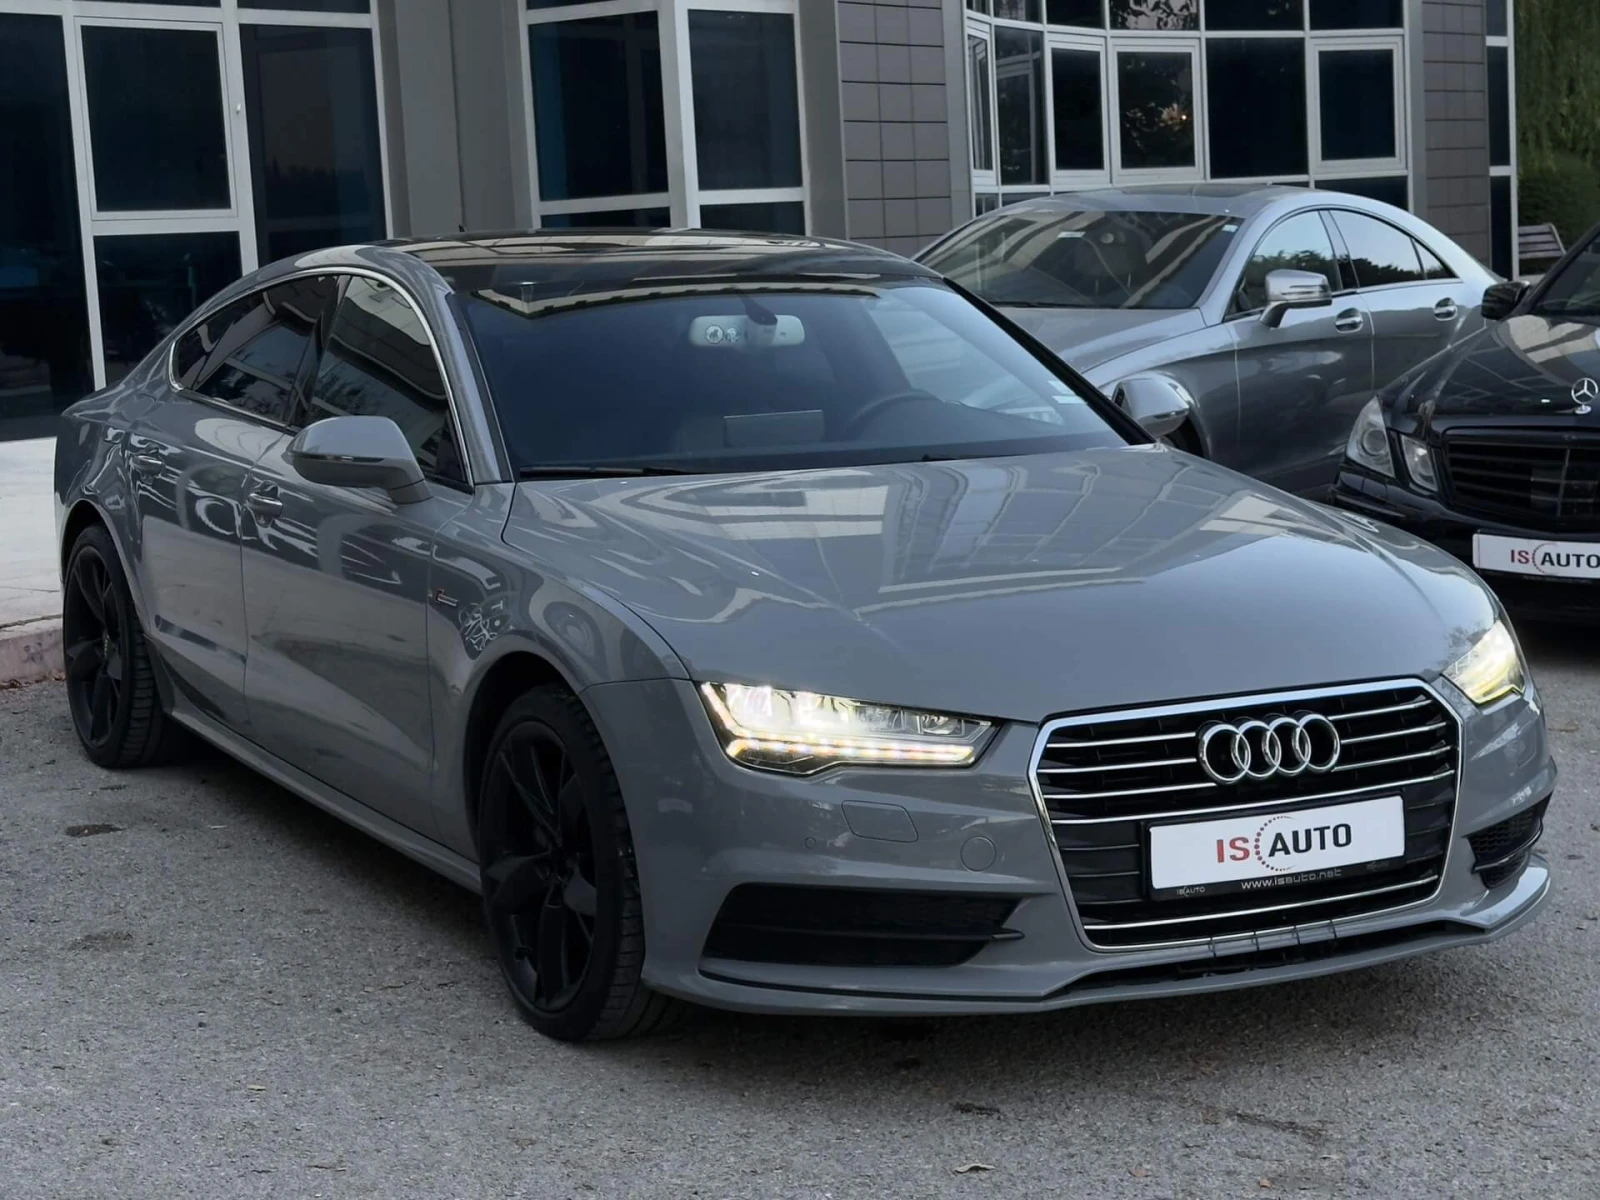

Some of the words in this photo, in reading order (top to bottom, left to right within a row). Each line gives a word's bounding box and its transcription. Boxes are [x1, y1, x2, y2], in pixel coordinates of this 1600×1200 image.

[1510, 549, 1530, 564] IS
[1540, 552, 1600, 569] AUTO
[1216, 836, 1251, 863] IS
[1268, 823, 1352, 858] AUTO
[1241, 868, 1342, 890] www.isauto.net
